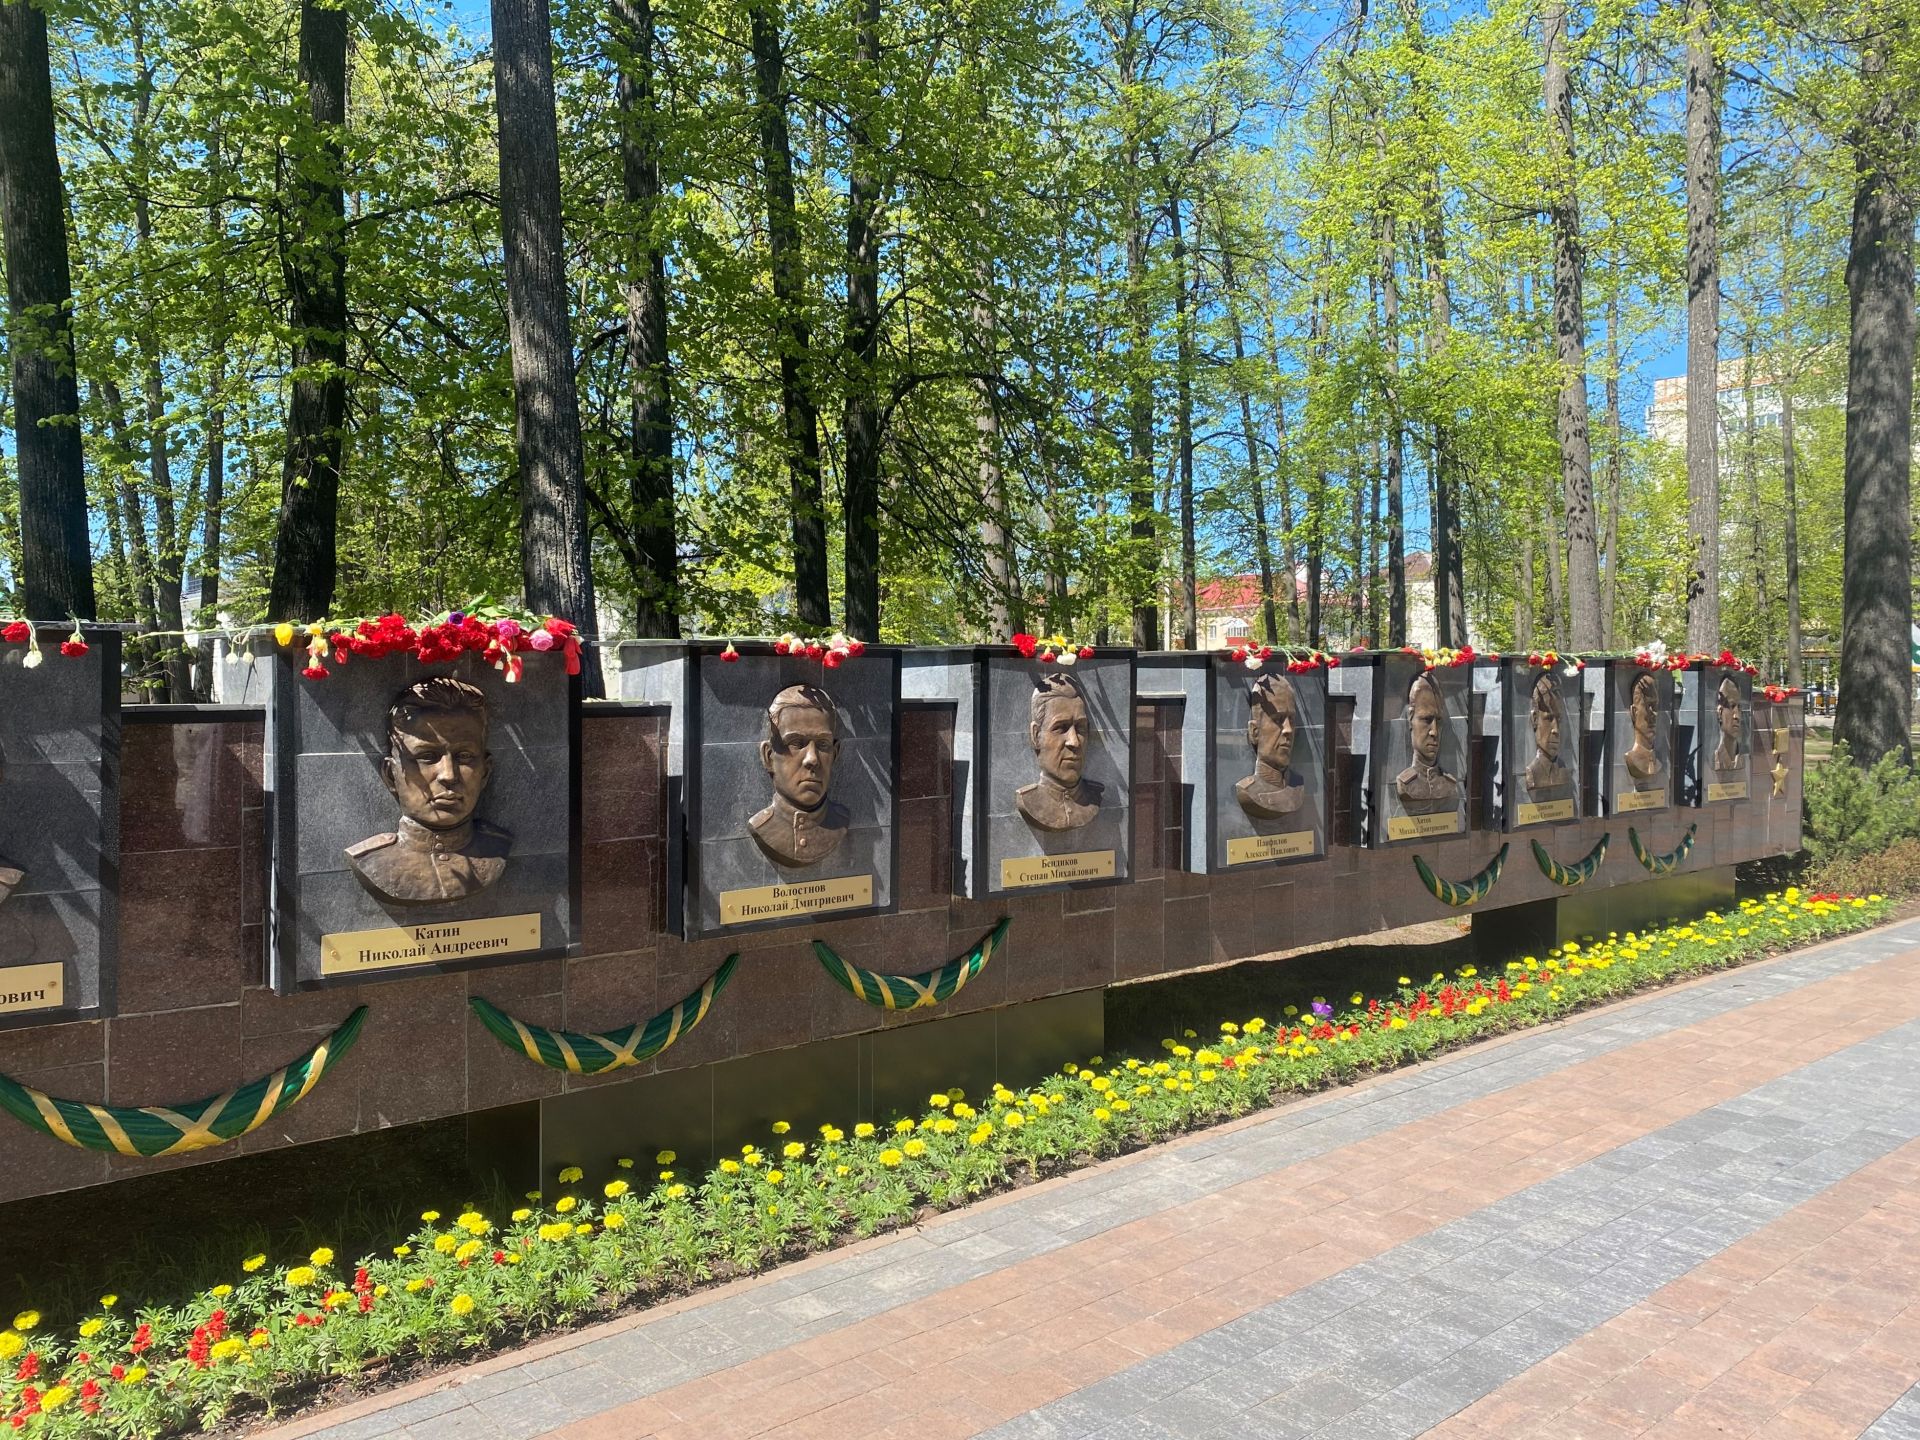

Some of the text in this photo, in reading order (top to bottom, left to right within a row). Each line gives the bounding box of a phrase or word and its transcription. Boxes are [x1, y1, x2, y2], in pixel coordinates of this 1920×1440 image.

[1256, 837, 1288, 848] Панфилов
[1244, 846, 1300, 860] Алексей Павлович
[1041, 858, 1078, 869] Бендиков
[1019, 867, 1099, 882] Степан Михайлович
[773, 883, 826, 898] Волостнов
[741, 893, 855, 916] Николай Дмитриевич
[415, 926, 461, 941] Катин
[359, 937, 509, 963] Николай Андреевич
